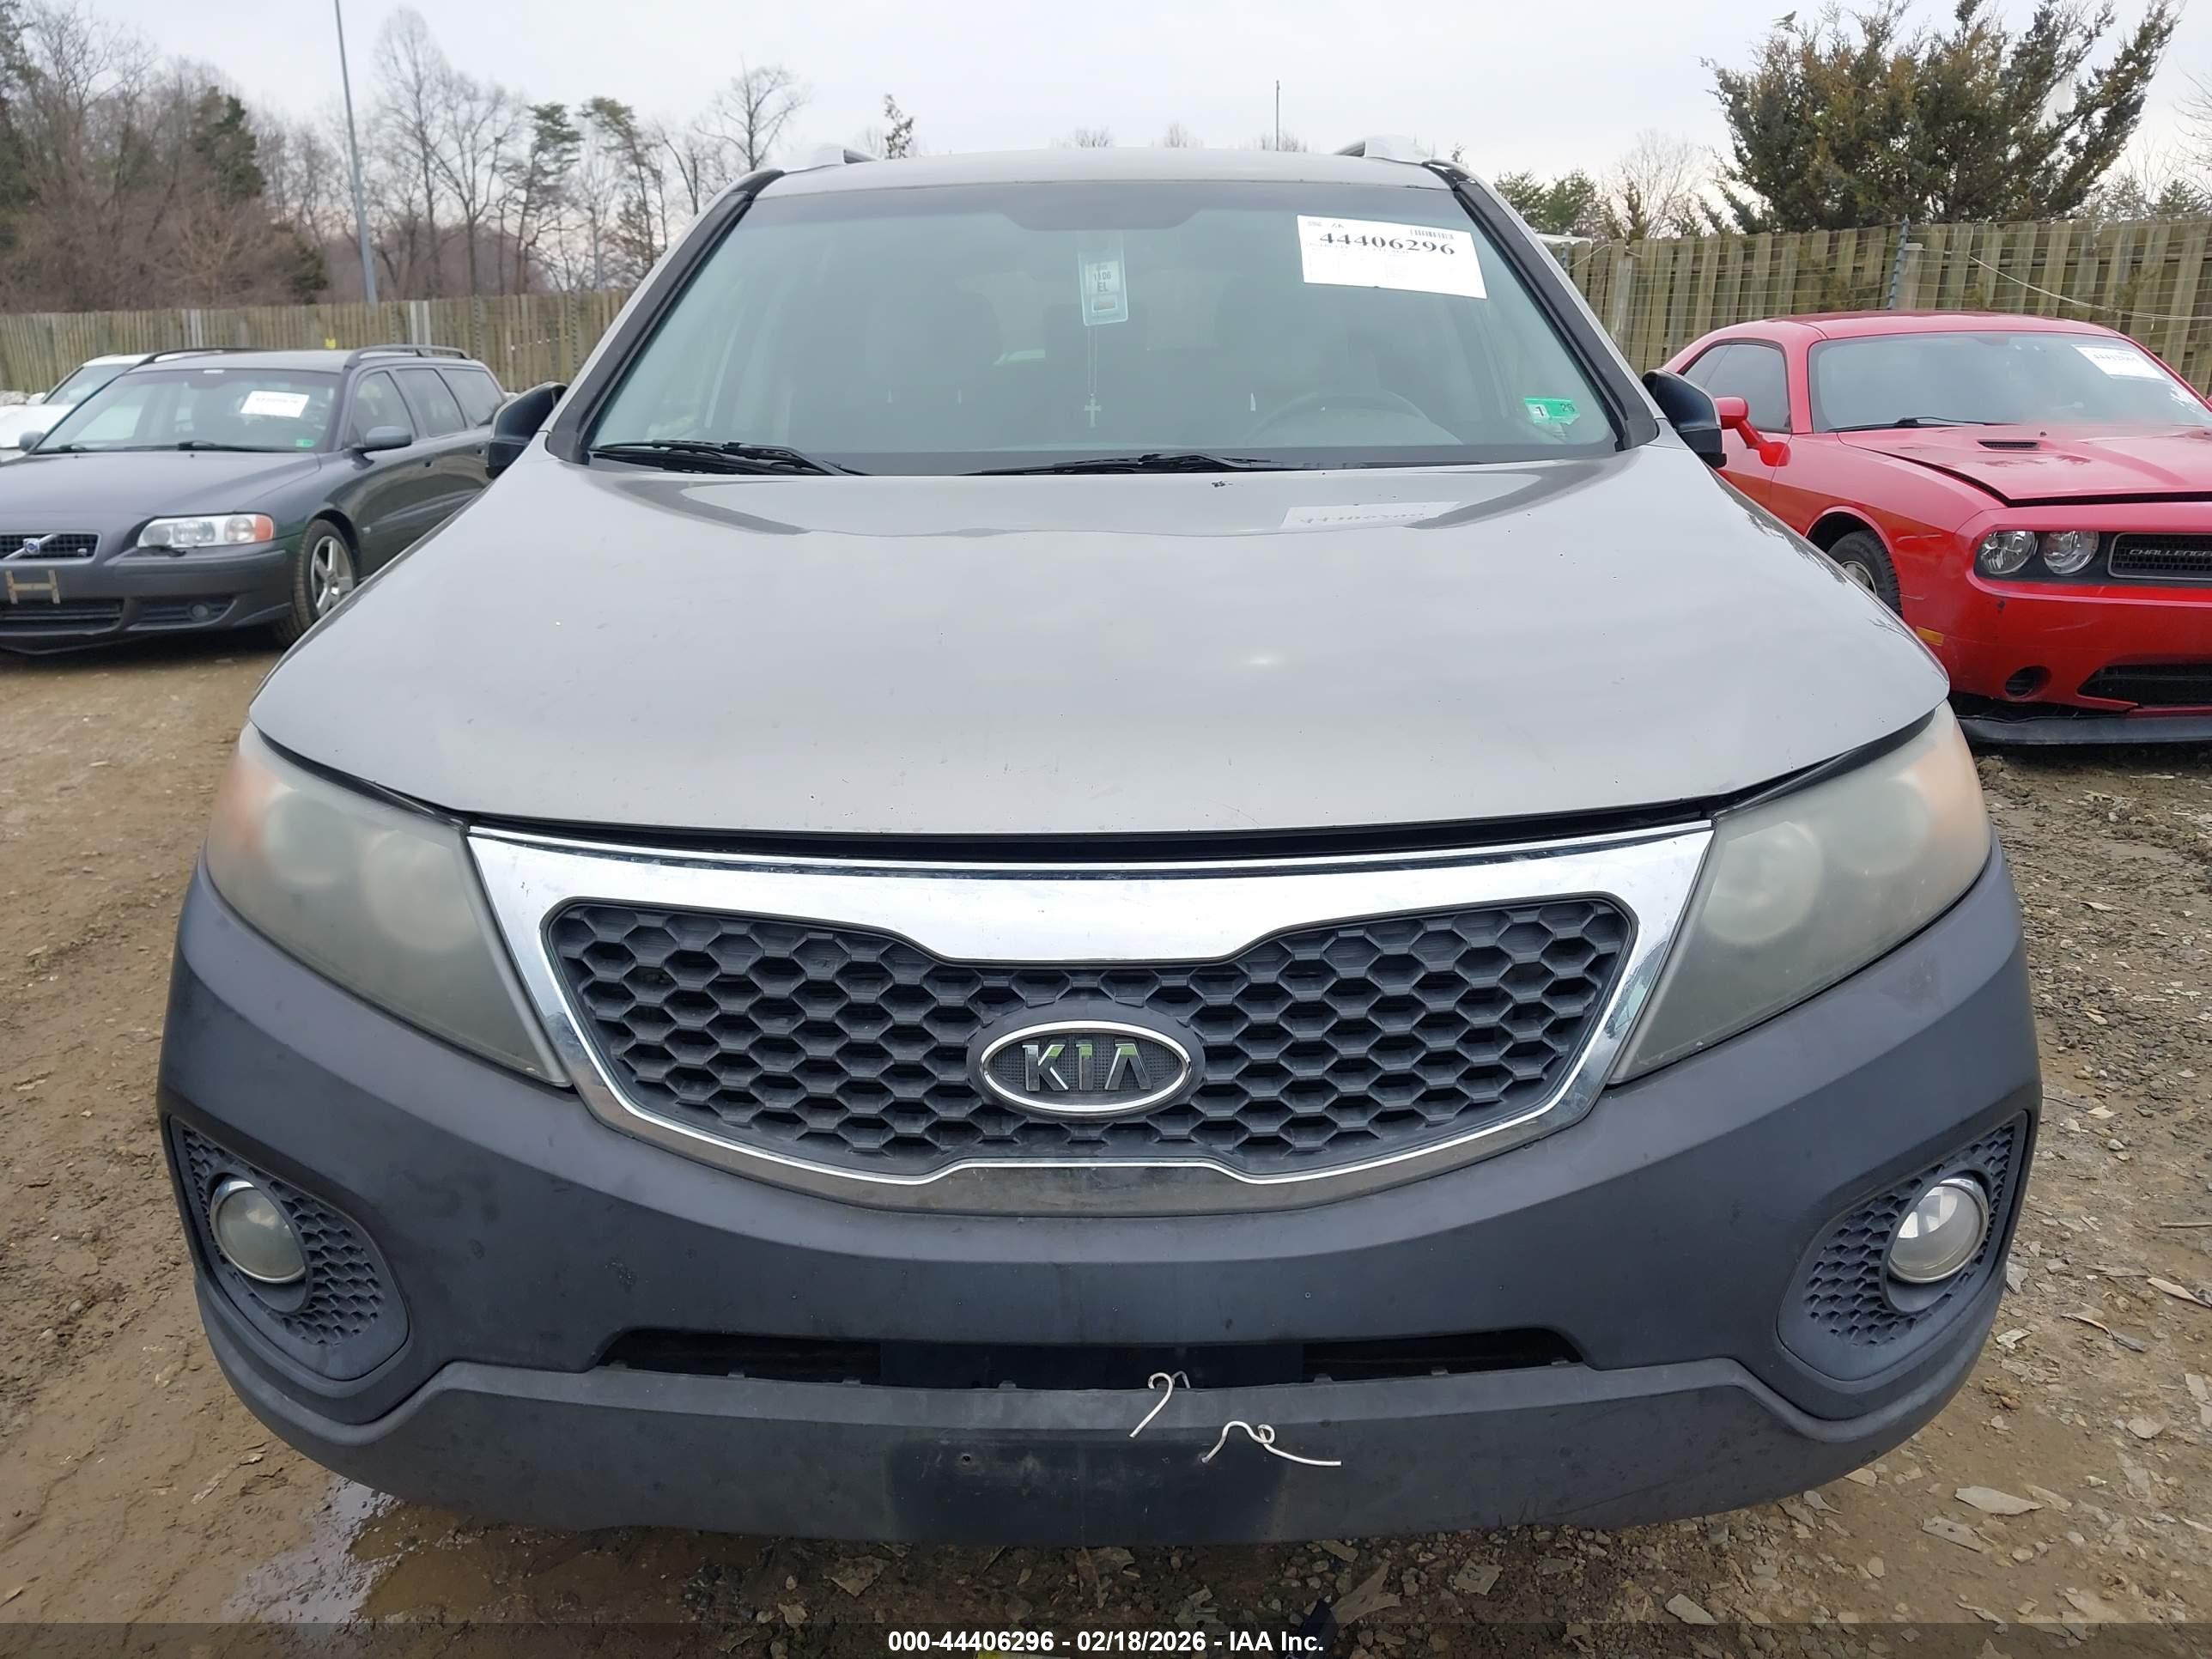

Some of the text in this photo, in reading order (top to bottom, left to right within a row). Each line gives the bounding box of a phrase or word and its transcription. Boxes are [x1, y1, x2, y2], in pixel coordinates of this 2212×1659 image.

[1320, 233, 1455, 255] 44406296
[2130, 549, 2212, 557] CHALLENGE
[1022, 1039, 1152, 1092] KIA
